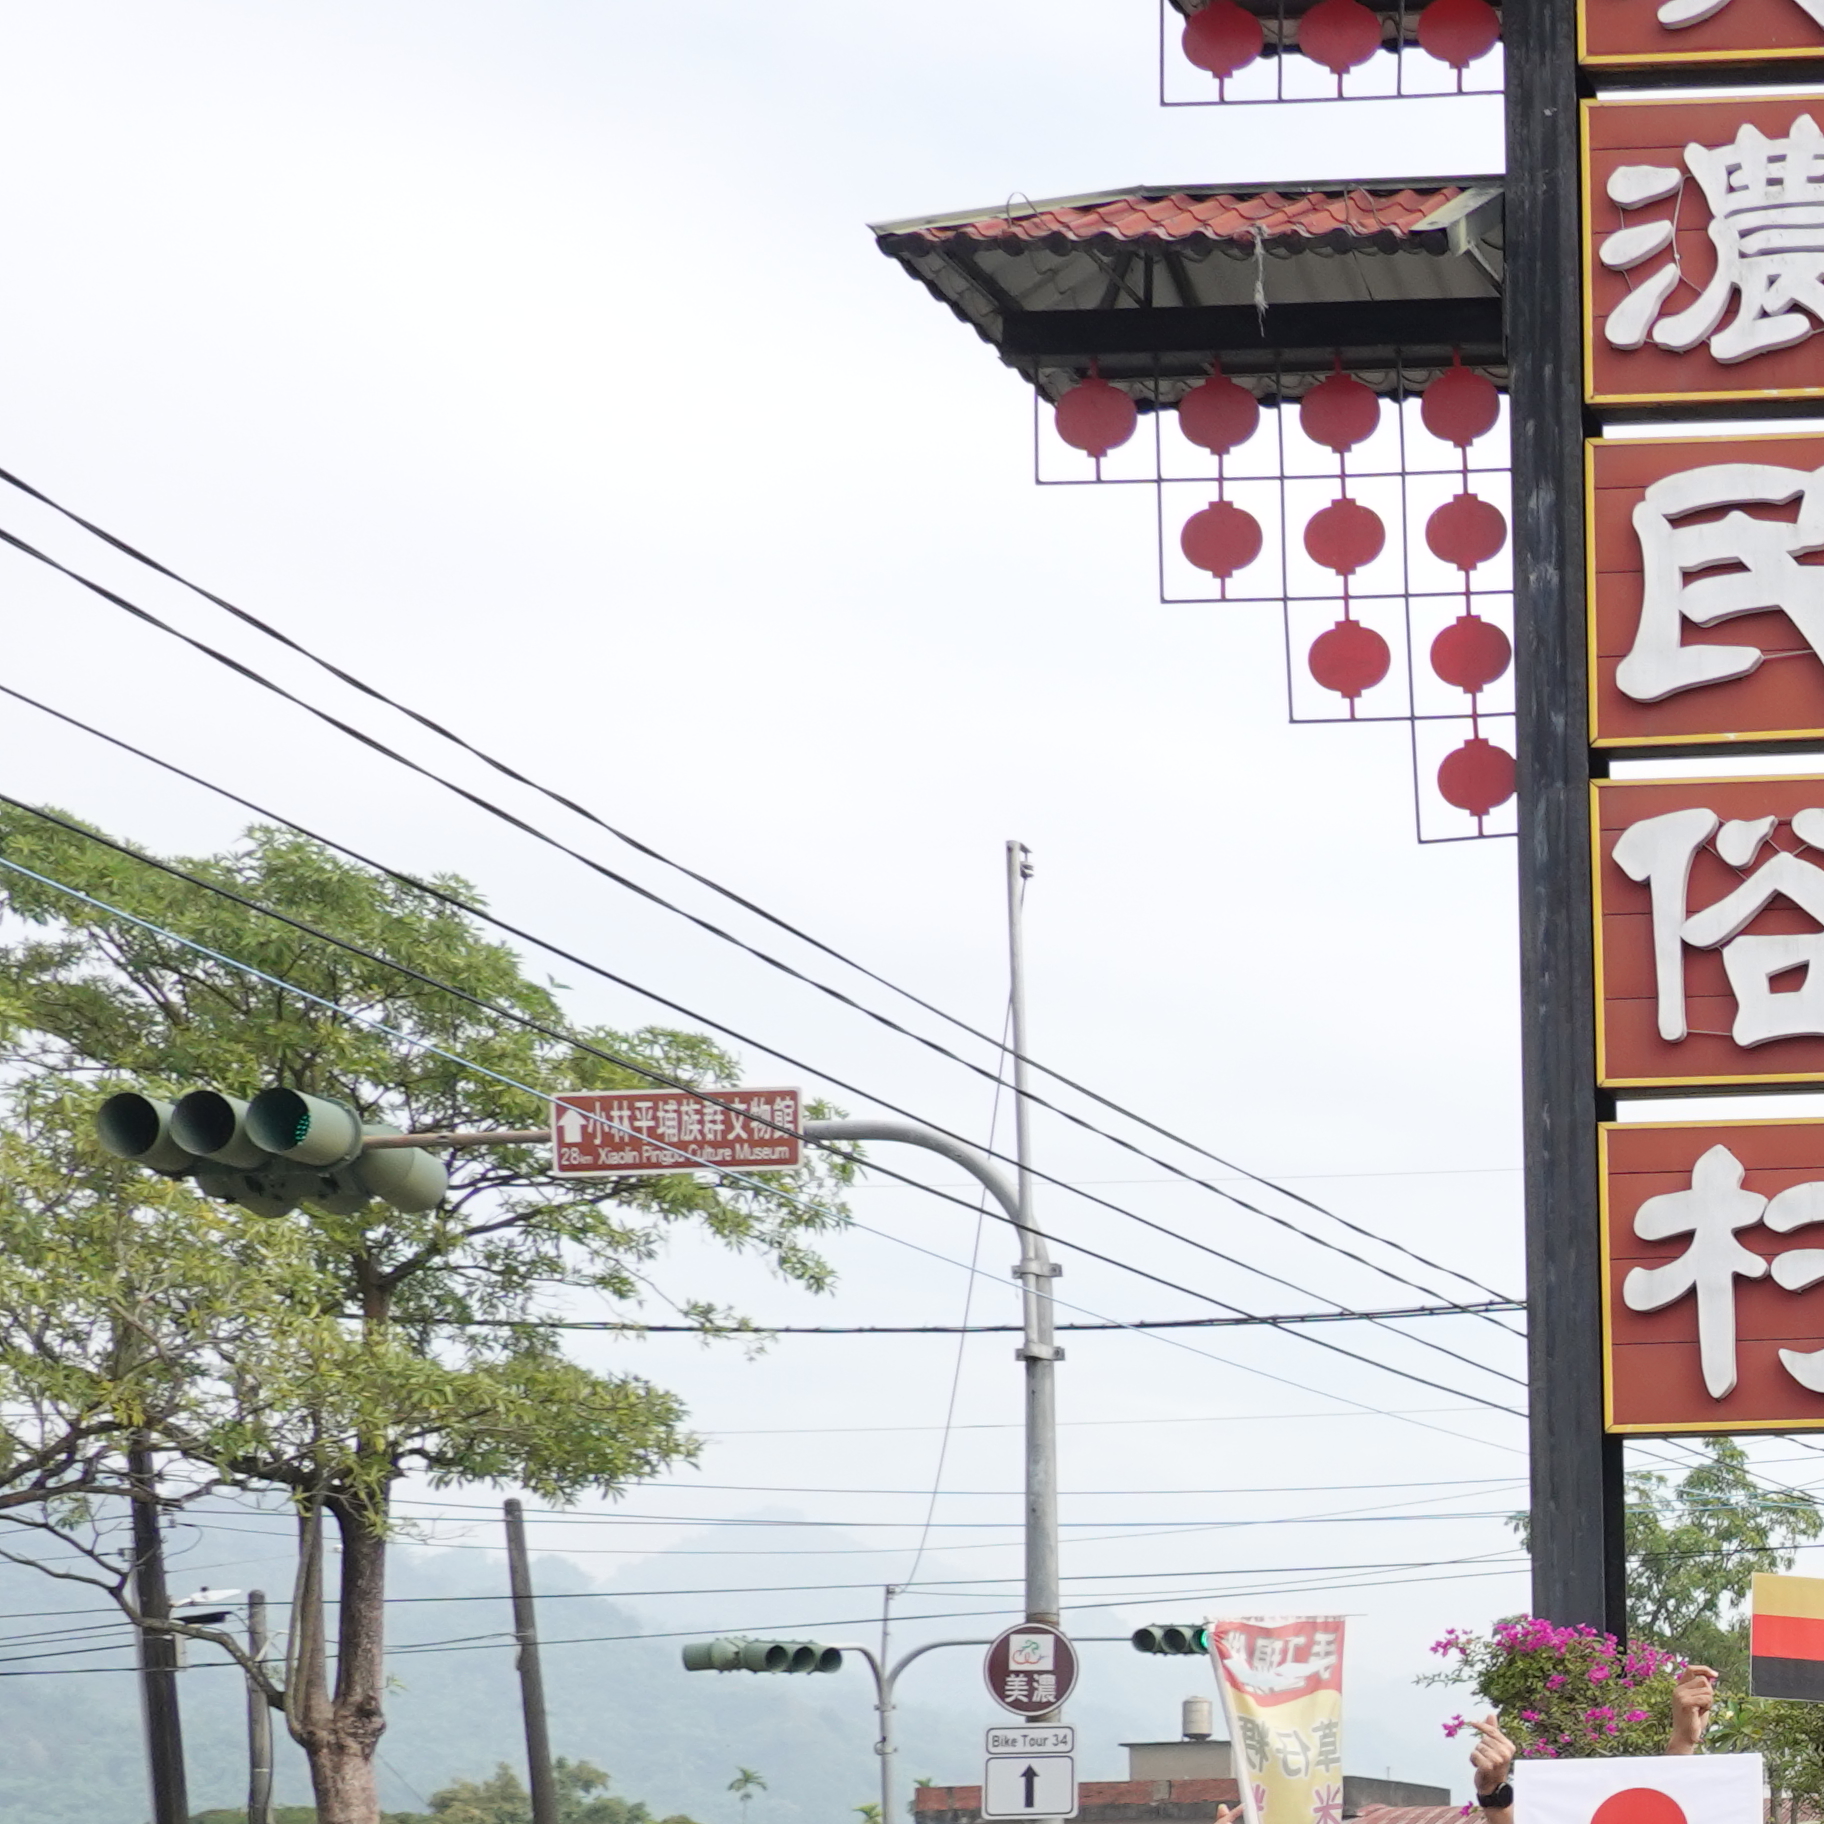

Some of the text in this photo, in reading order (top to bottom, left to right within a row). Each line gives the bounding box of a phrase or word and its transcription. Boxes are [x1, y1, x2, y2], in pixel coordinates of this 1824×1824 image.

[587, 1096, 796, 1145] 小林平埔族群文物館
[688, 1144, 733, 1162] Culture
[735, 1143, 790, 1161] Museum
[1004, 1673, 1057, 1703] 美濃
[991, 1733, 1069, 1748] Bike Tour 34
